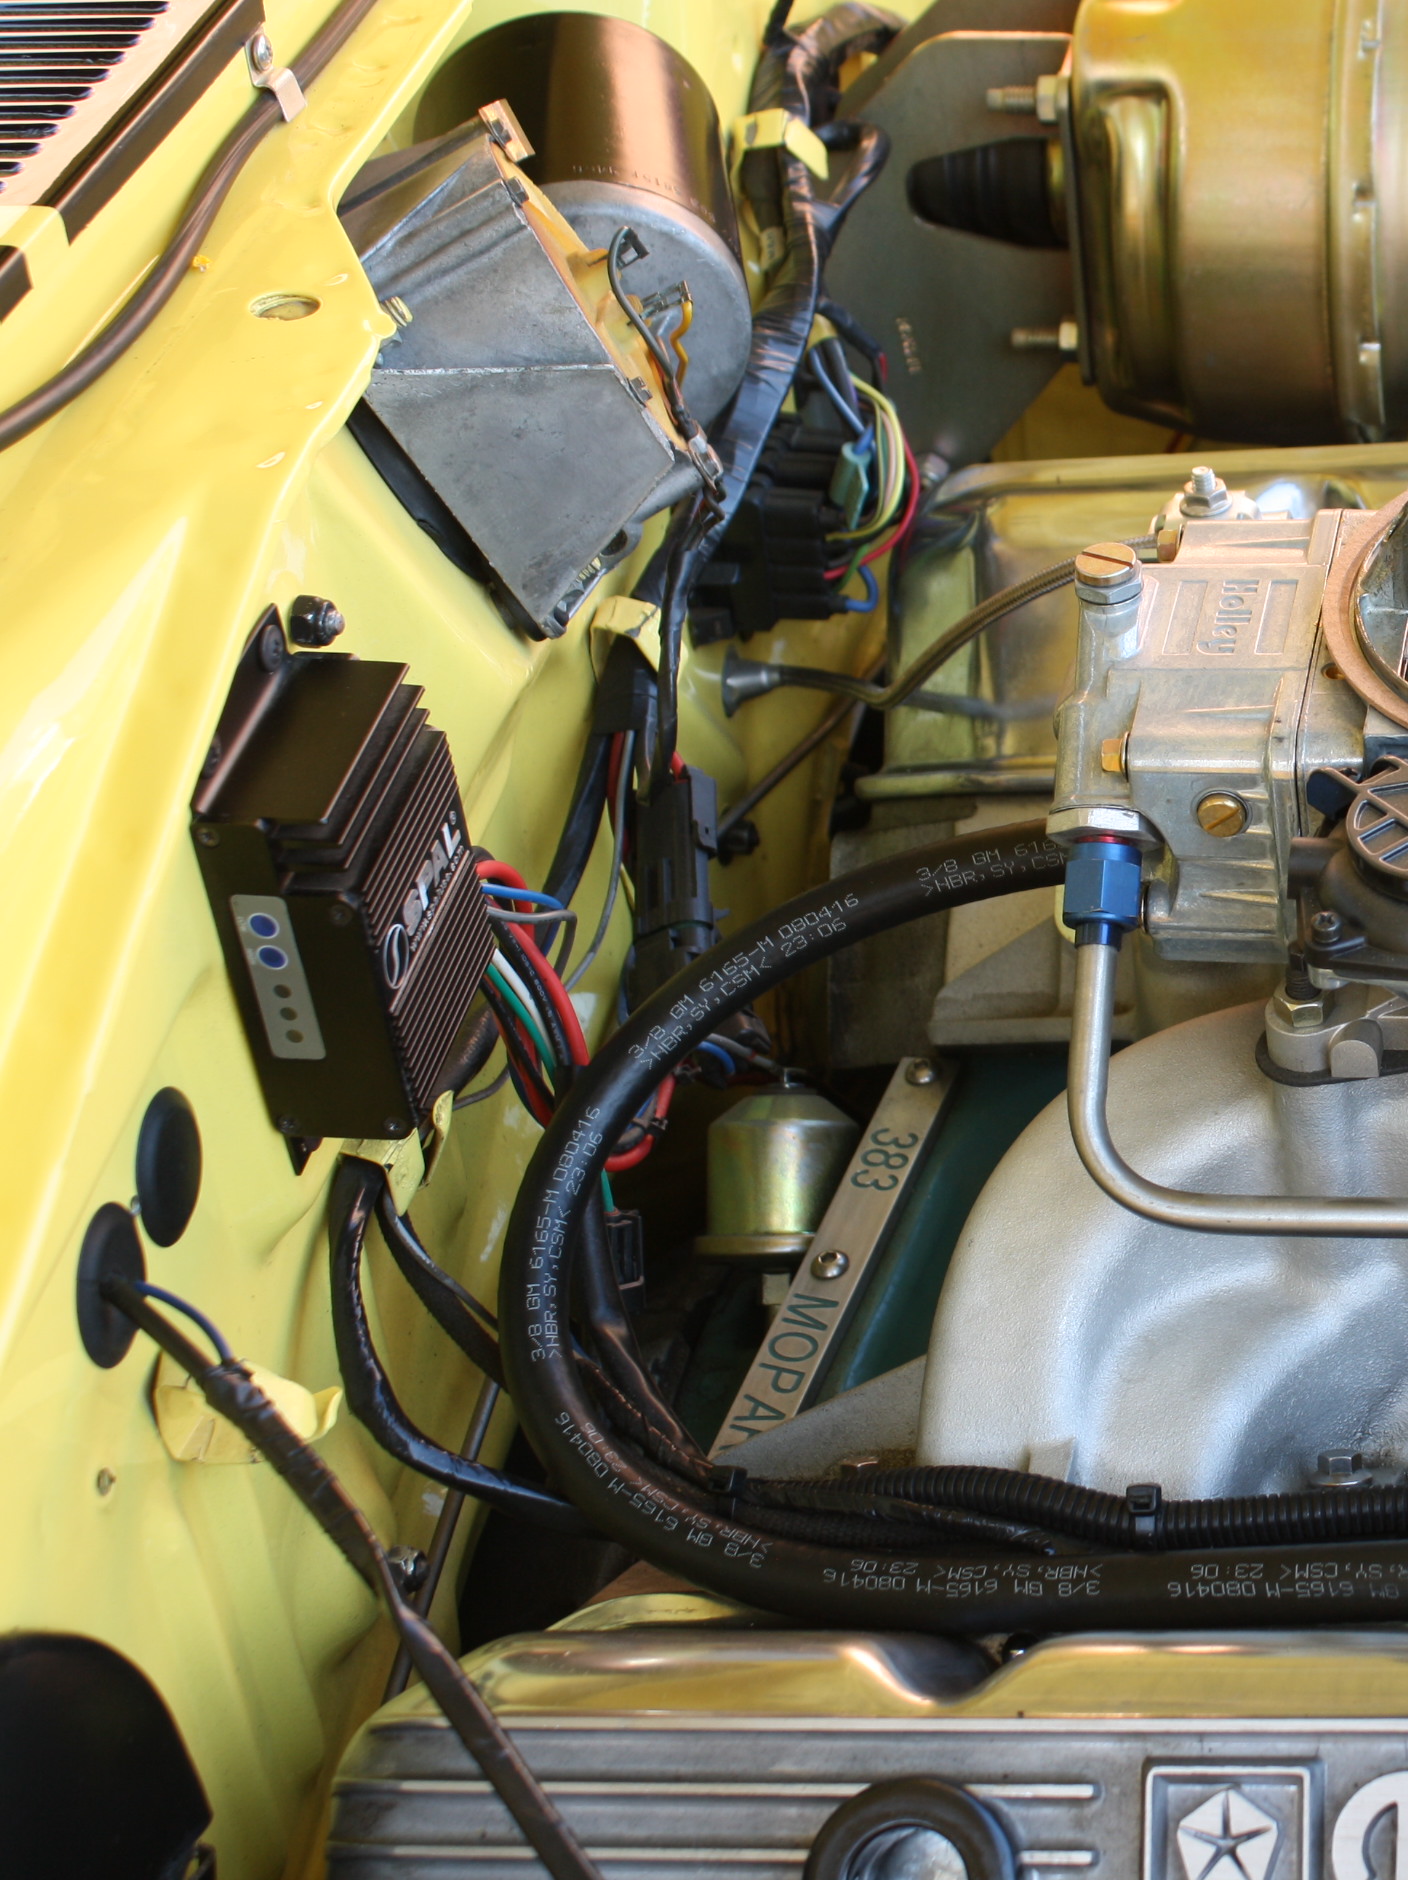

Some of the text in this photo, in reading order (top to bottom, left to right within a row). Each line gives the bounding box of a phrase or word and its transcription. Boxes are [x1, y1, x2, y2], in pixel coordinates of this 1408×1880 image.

[1197, 580, 1260, 655] Holley
[403, 822, 461, 936] SPAL
[916, 859, 959, 881] 3/8
[971, 848, 1001, 866] GM
[781, 917, 847, 957] 23:06
[628, 1025, 666, 1059] 3/8
[669, 994, 694, 1021] GM
[699, 935, 774, 992] 6165-M
[565, 1132, 603, 1196] 23:06
[850, 1127, 919, 1192] 383
[528, 1189, 560, 1269] 6165-M
[526, 1283, 541, 1312] GM
[528, 1323, 546, 1362] 3/8
[607, 1477, 679, 1531] 6165-M
[686, 1528, 714, 1547] GM
[724, 1541, 766, 1569] 3/8
[850, 1558, 919, 1574] 23:06
[1190, 1563, 1264, 1580] 23:06
[916, 1578, 998, 1598] 6165-M
[1014, 1579, 1043, 1597] GM
[1058, 1579, 1101, 1598] 3/8
[1265, 1581, 1354, 1599] 6165-M
[1370, 1582, 1399, 1599] GM
